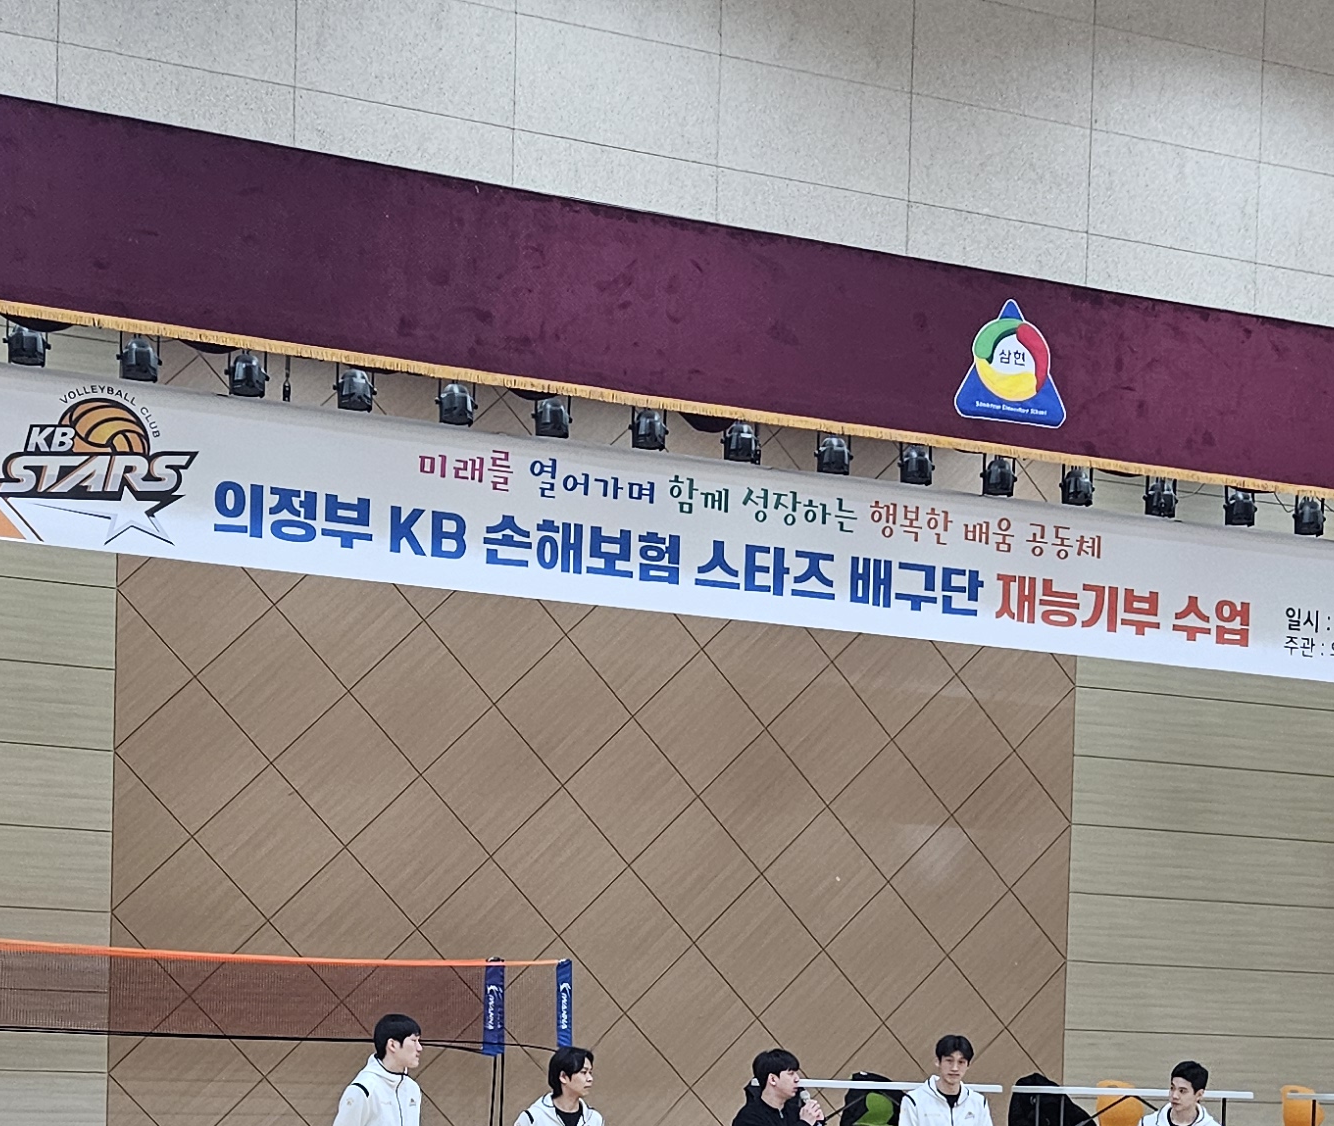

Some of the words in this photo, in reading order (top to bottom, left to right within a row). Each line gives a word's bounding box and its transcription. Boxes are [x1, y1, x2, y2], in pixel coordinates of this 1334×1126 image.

[999, 349, 1026, 367] 삼현
[59, 384, 137, 406] VOLLEYBALL
[139, 406, 161, 439] CLUB
[27, 426, 76, 452] KB
[419, 449, 514, 493] 미래를
[530, 458, 655, 504] 열어가며
[668, 474, 729, 515] 함께
[742, 487, 857, 533] 성장하는
[870, 500, 953, 546] 행복한
[963, 517, 1015, 554] 배움
[1025, 522, 1102, 560] 공동체
[213, 480, 373, 549] 의정부
[389, 505, 467, 560] KB
[483, 513, 681, 586] 손해보험
[694, 539, 835, 601] 스타즈
[849, 555, 984, 617] 배구단
[995, 573, 1161, 637] 재능기부
[1172, 595, 1251, 648] 수업
[1285, 607, 1319, 633] 일시
[1284, 635, 1316, 658] 주관
